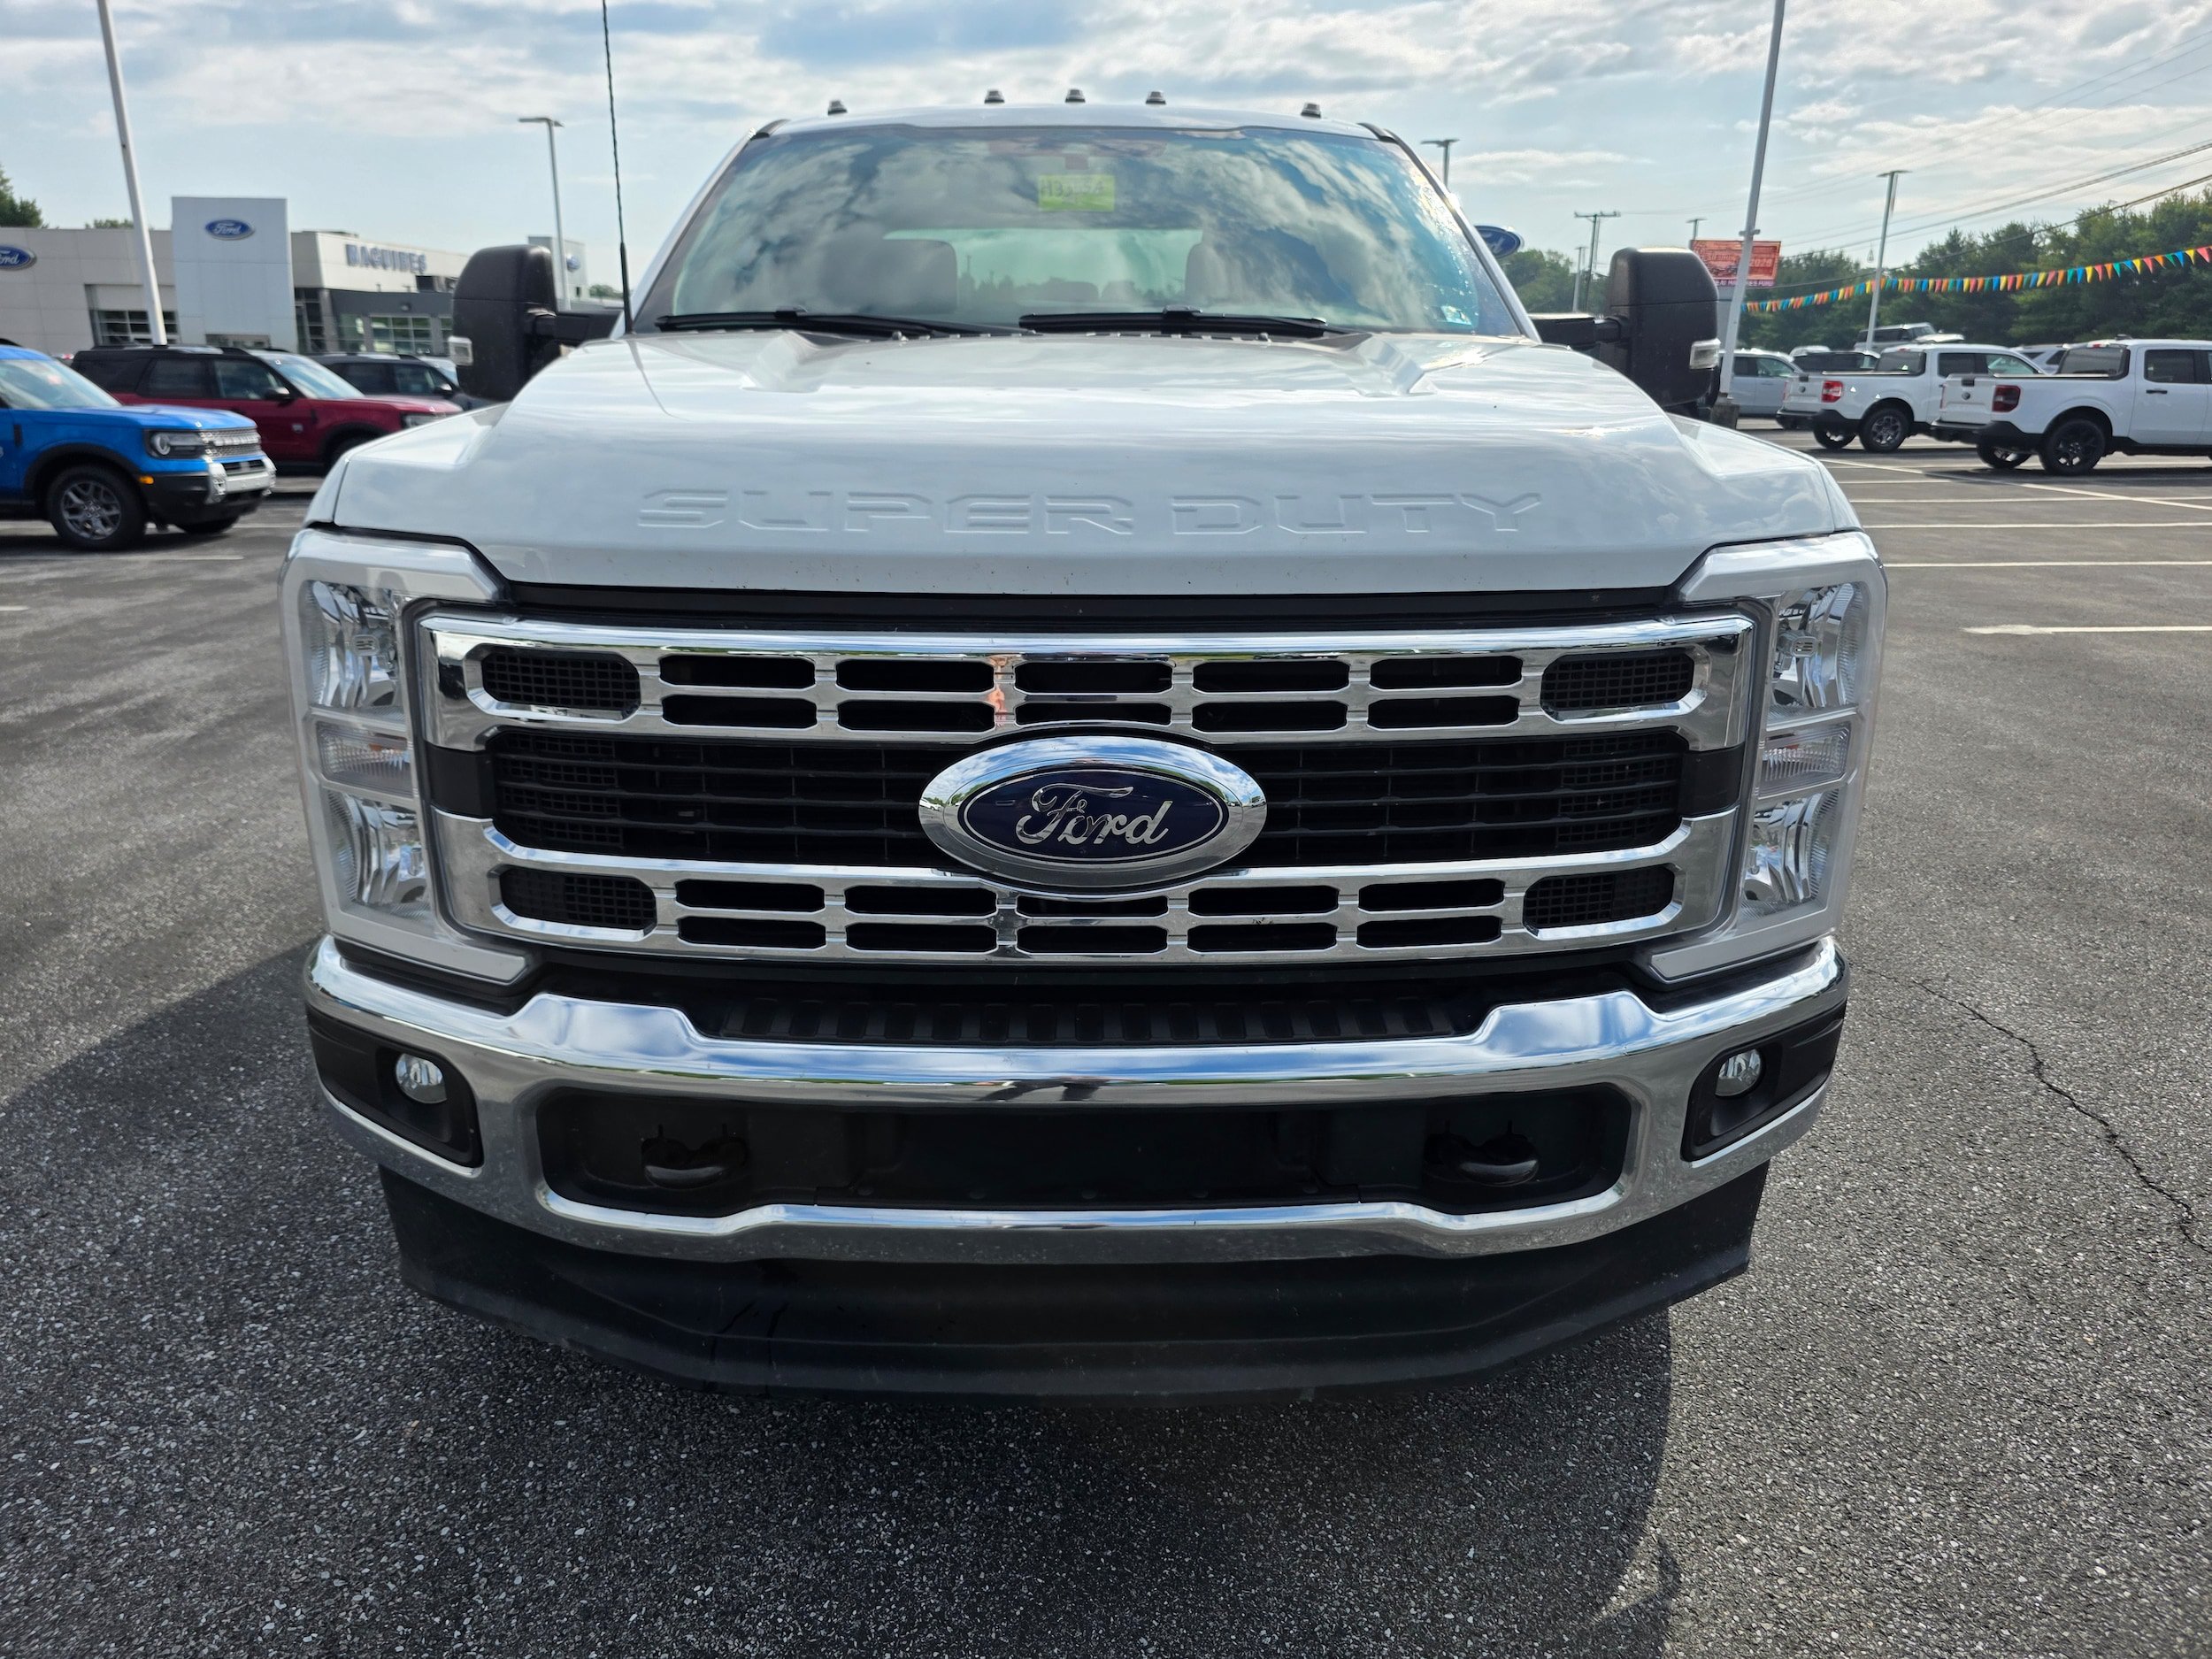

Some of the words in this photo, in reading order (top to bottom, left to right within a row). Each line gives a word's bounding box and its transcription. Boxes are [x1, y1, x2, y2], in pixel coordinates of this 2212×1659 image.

[213, 223, 242, 234] Ford
[638, 488, 1134, 534] SUPER
[1170, 492, 1542, 535] DUTY
[1015, 782, 1170, 845] Ford
